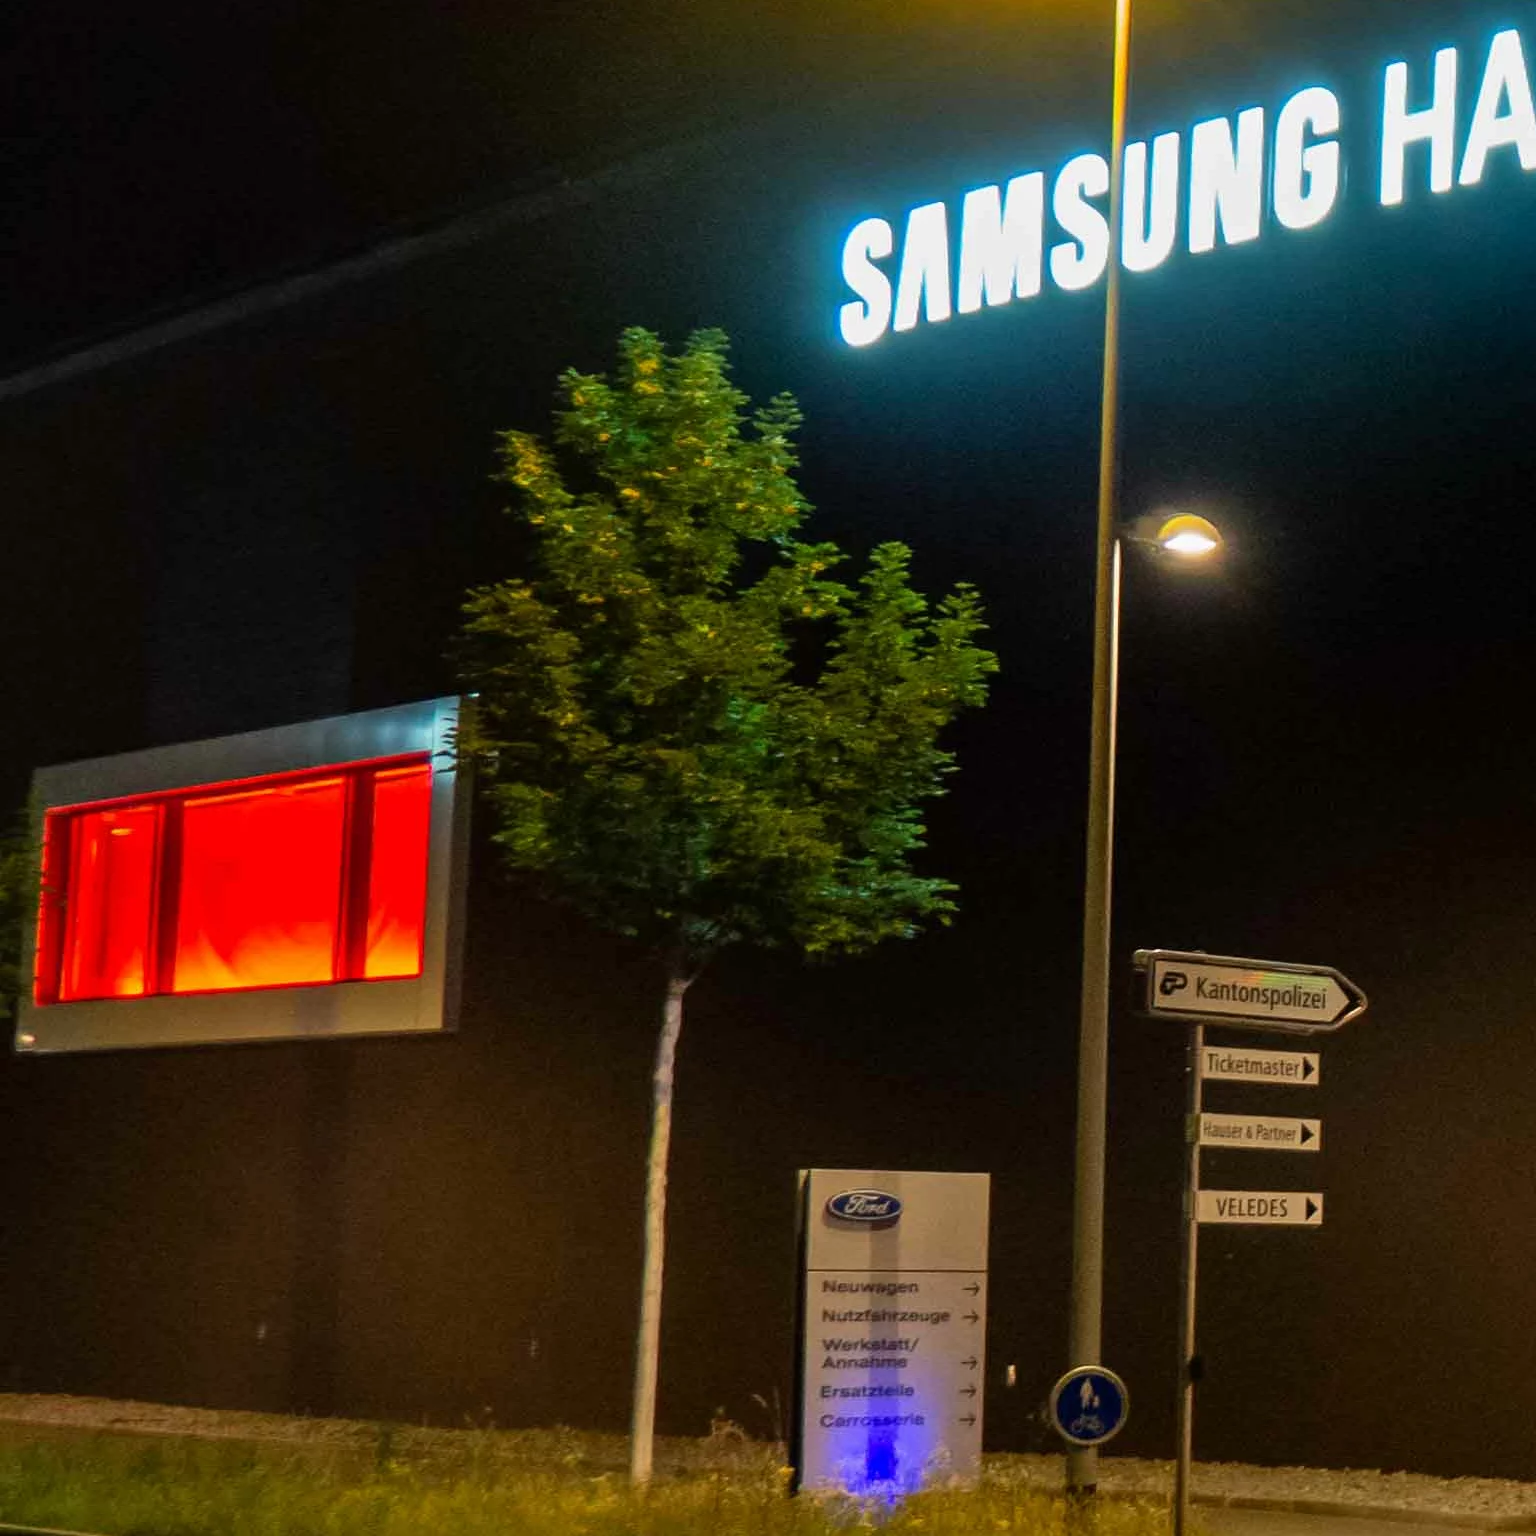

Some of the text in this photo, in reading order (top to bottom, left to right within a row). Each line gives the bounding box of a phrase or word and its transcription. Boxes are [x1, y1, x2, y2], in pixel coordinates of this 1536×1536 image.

[838, 85, 1340, 348] SAMSUNG
[1196, 976, 1327, 1010] Kantonspolizei
[1207, 1053, 1300, 1077] Ticketmaster
[1256, 1124, 1297, 1141] Partner
[844, 1193, 891, 1216] Ford
[1216, 1197, 1288, 1218] VELEDES
[822, 1280, 919, 1296] Neuwagen
[822, 1309, 951, 1325] Nutzfahrzeuge
[822, 1338, 920, 1352] Werkstatt/
[822, 1356, 908, 1369] Annahme
[820, 1384, 915, 1399] Ersatzteile
[819, 1412, 925, 1428] Carrosserie
